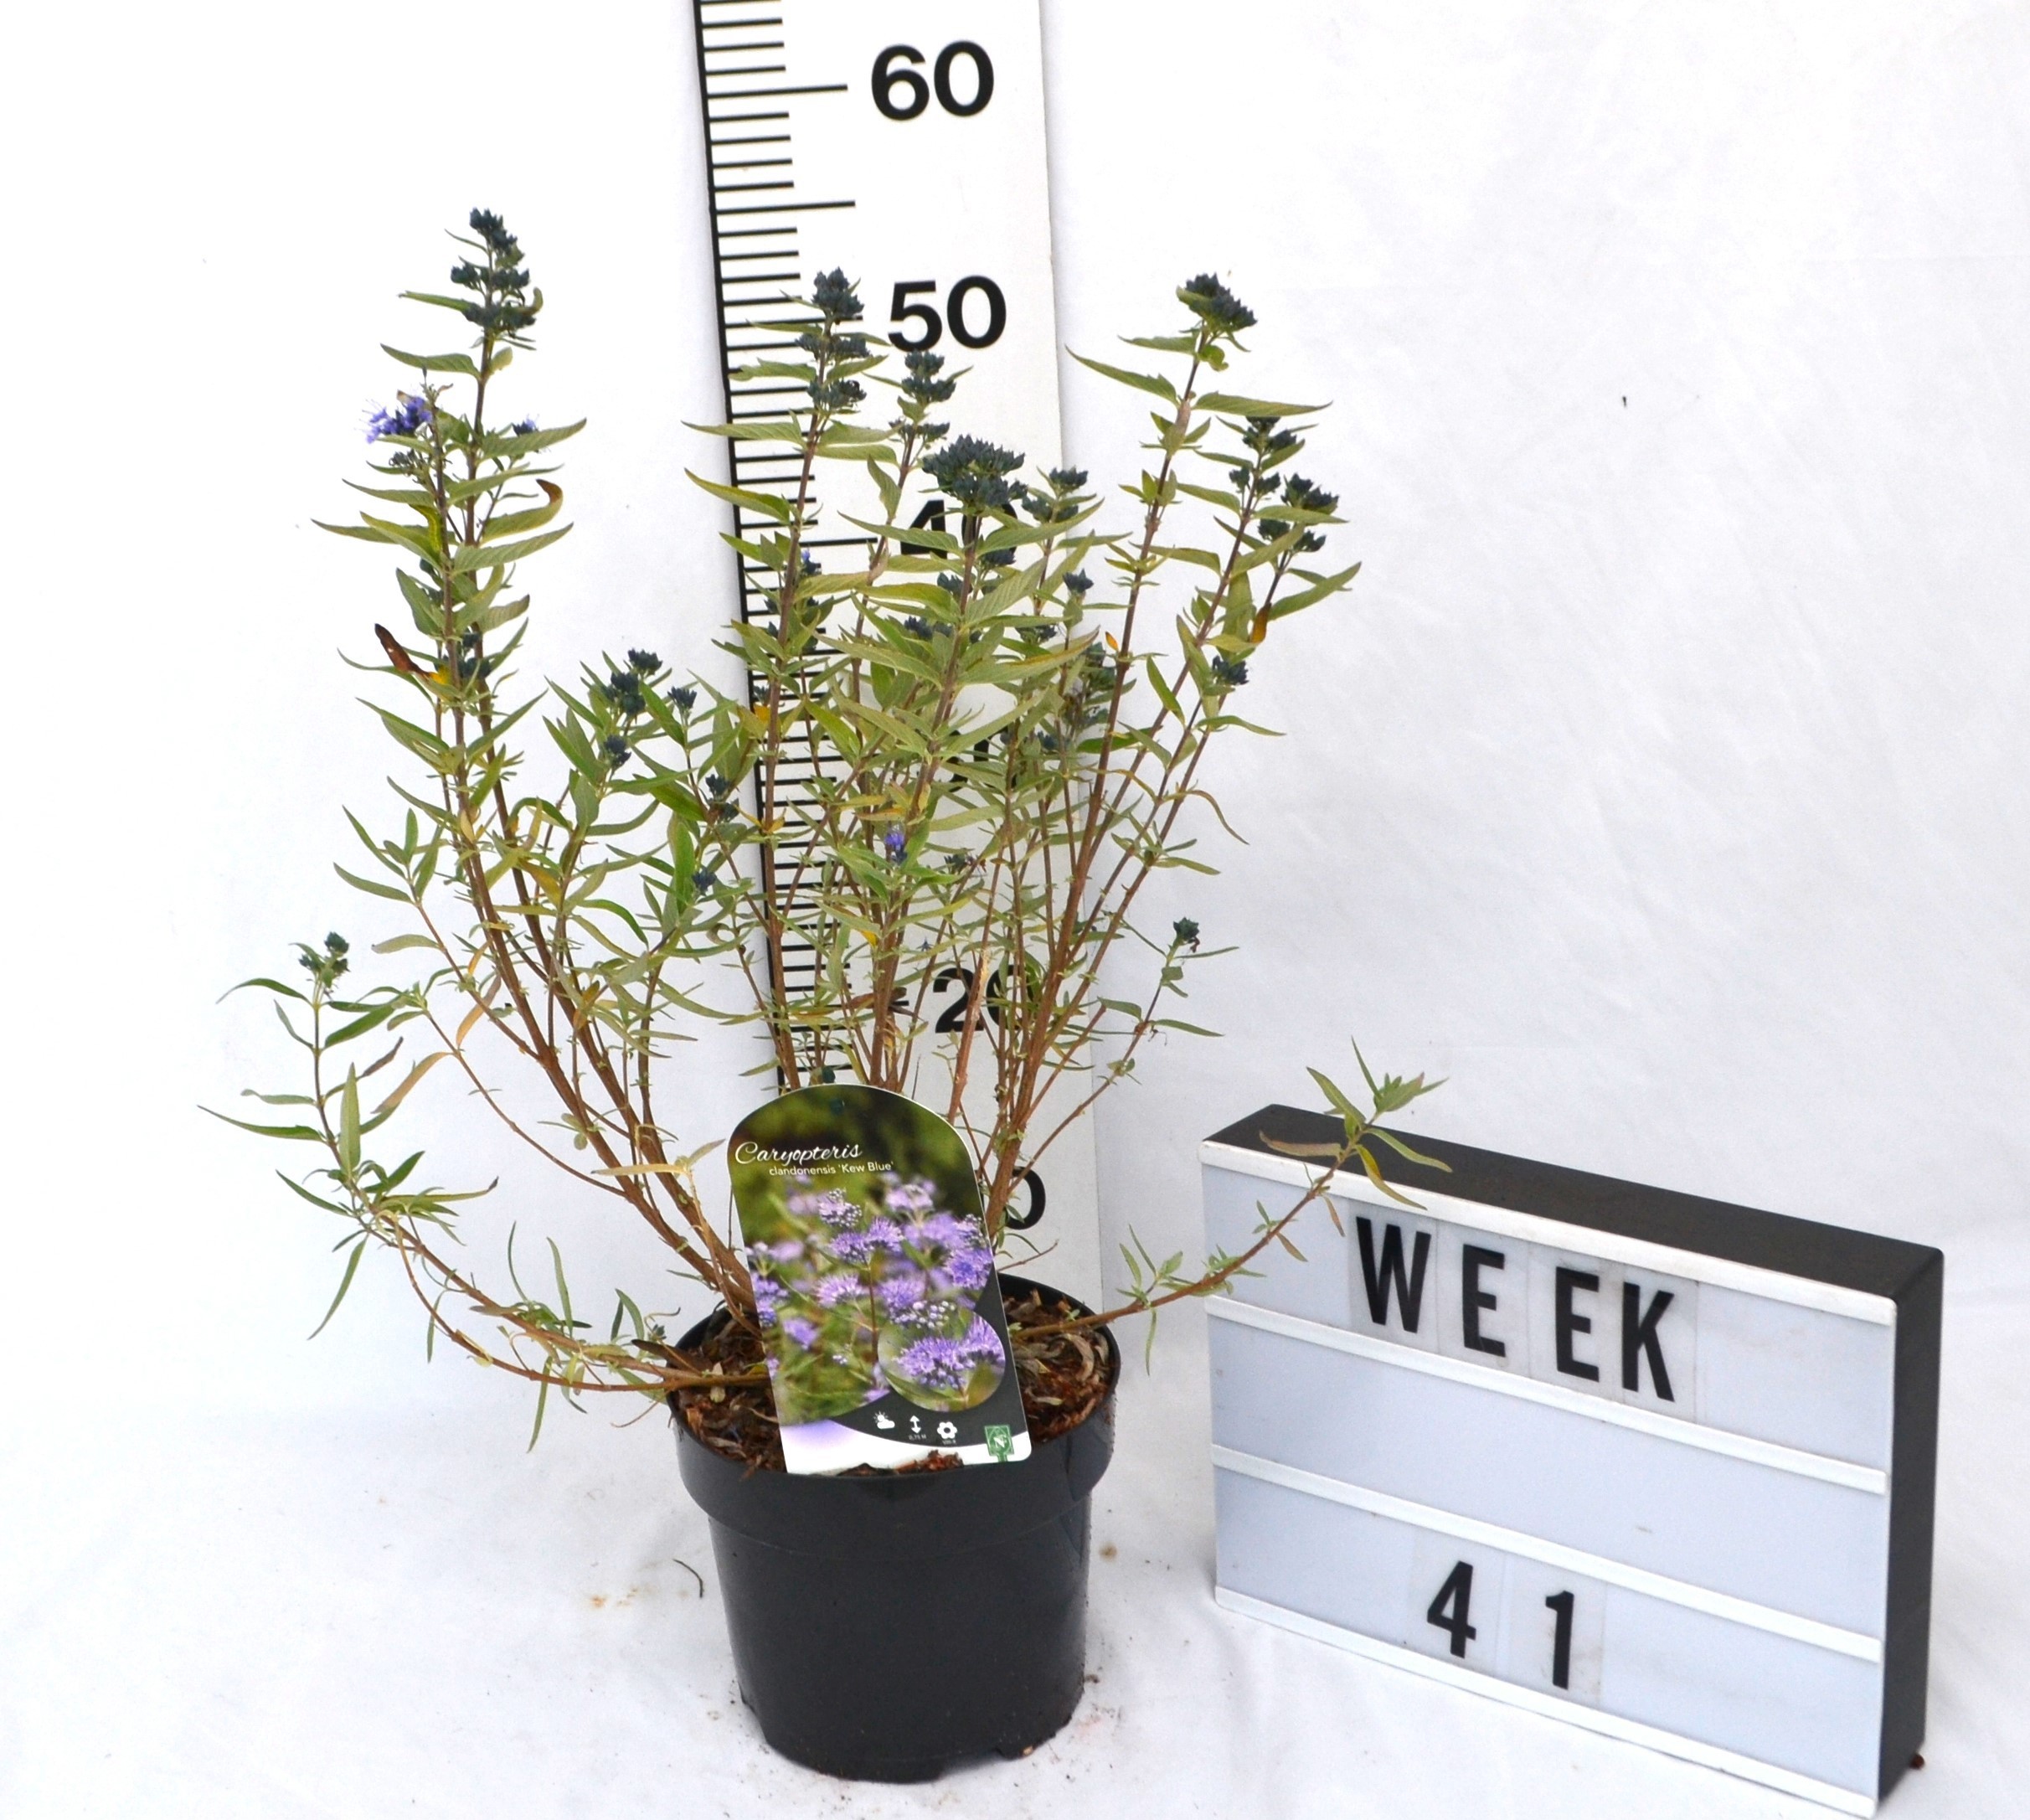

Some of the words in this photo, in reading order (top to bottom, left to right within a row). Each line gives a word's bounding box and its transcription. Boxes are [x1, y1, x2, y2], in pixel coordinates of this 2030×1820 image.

[871, 40, 994, 121] 60
[888, 275, 1007, 352] 50
[900, 498, 1018, 559] 4
[734, 1141, 863, 1166] Caryopteris
[769, 1164, 836, 1176] clandonensis
[974, 1166, 1046, 1230] 0
[1356, 1216, 1677, 1402] WEEK
[1426, 1560, 1575, 1690] 41
